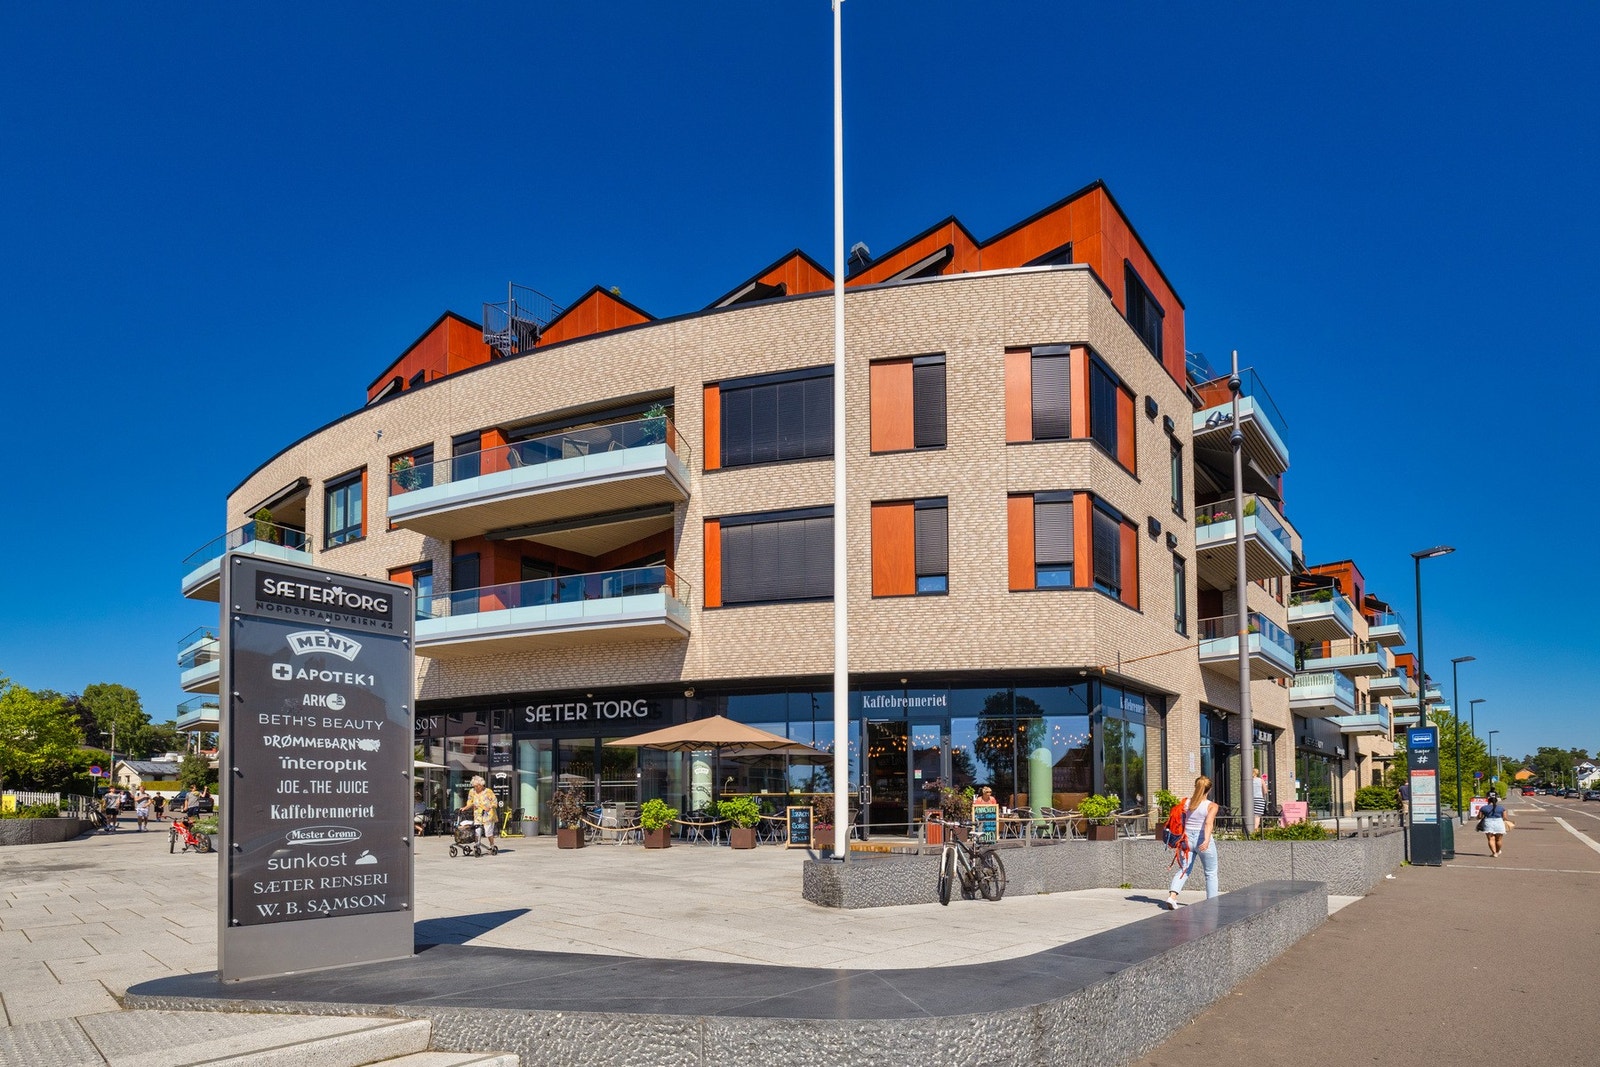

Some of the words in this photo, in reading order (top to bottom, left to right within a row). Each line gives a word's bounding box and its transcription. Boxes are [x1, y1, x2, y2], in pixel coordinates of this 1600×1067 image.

[256, 601, 377, 626] NORDSTRANDVEIEN
[381, 621, 394, 630] 42
[296, 635, 354, 653] MENY
[302, 693, 327, 707] ARK
[863, 694, 947, 709] Kaffebrenneriet
[525, 703, 587, 722] SÆTER
[592, 699, 648, 719] TORG
[258, 713, 317, 727] BETH'S
[322, 717, 384, 730] BEAUTY
[414, 717, 438, 730] SON
[263, 735, 358, 751] DRØMMEBARN
[277, 780, 300, 794] JOE
[310, 780, 332, 794] THE
[336, 781, 369, 794] JUICE
[271, 804, 375, 819] Kaffebrenneriet
[291, 830, 325, 839] Mester
[327, 829, 357, 839] Grønn
[267, 853, 348, 870] sunkost
[253, 878, 315, 894] SÆTER
[320, 873, 388, 889] RENSERI
[256, 903, 280, 917] W.
[286, 902, 302, 915] B.
[307, 894, 387, 913] SAMSON
